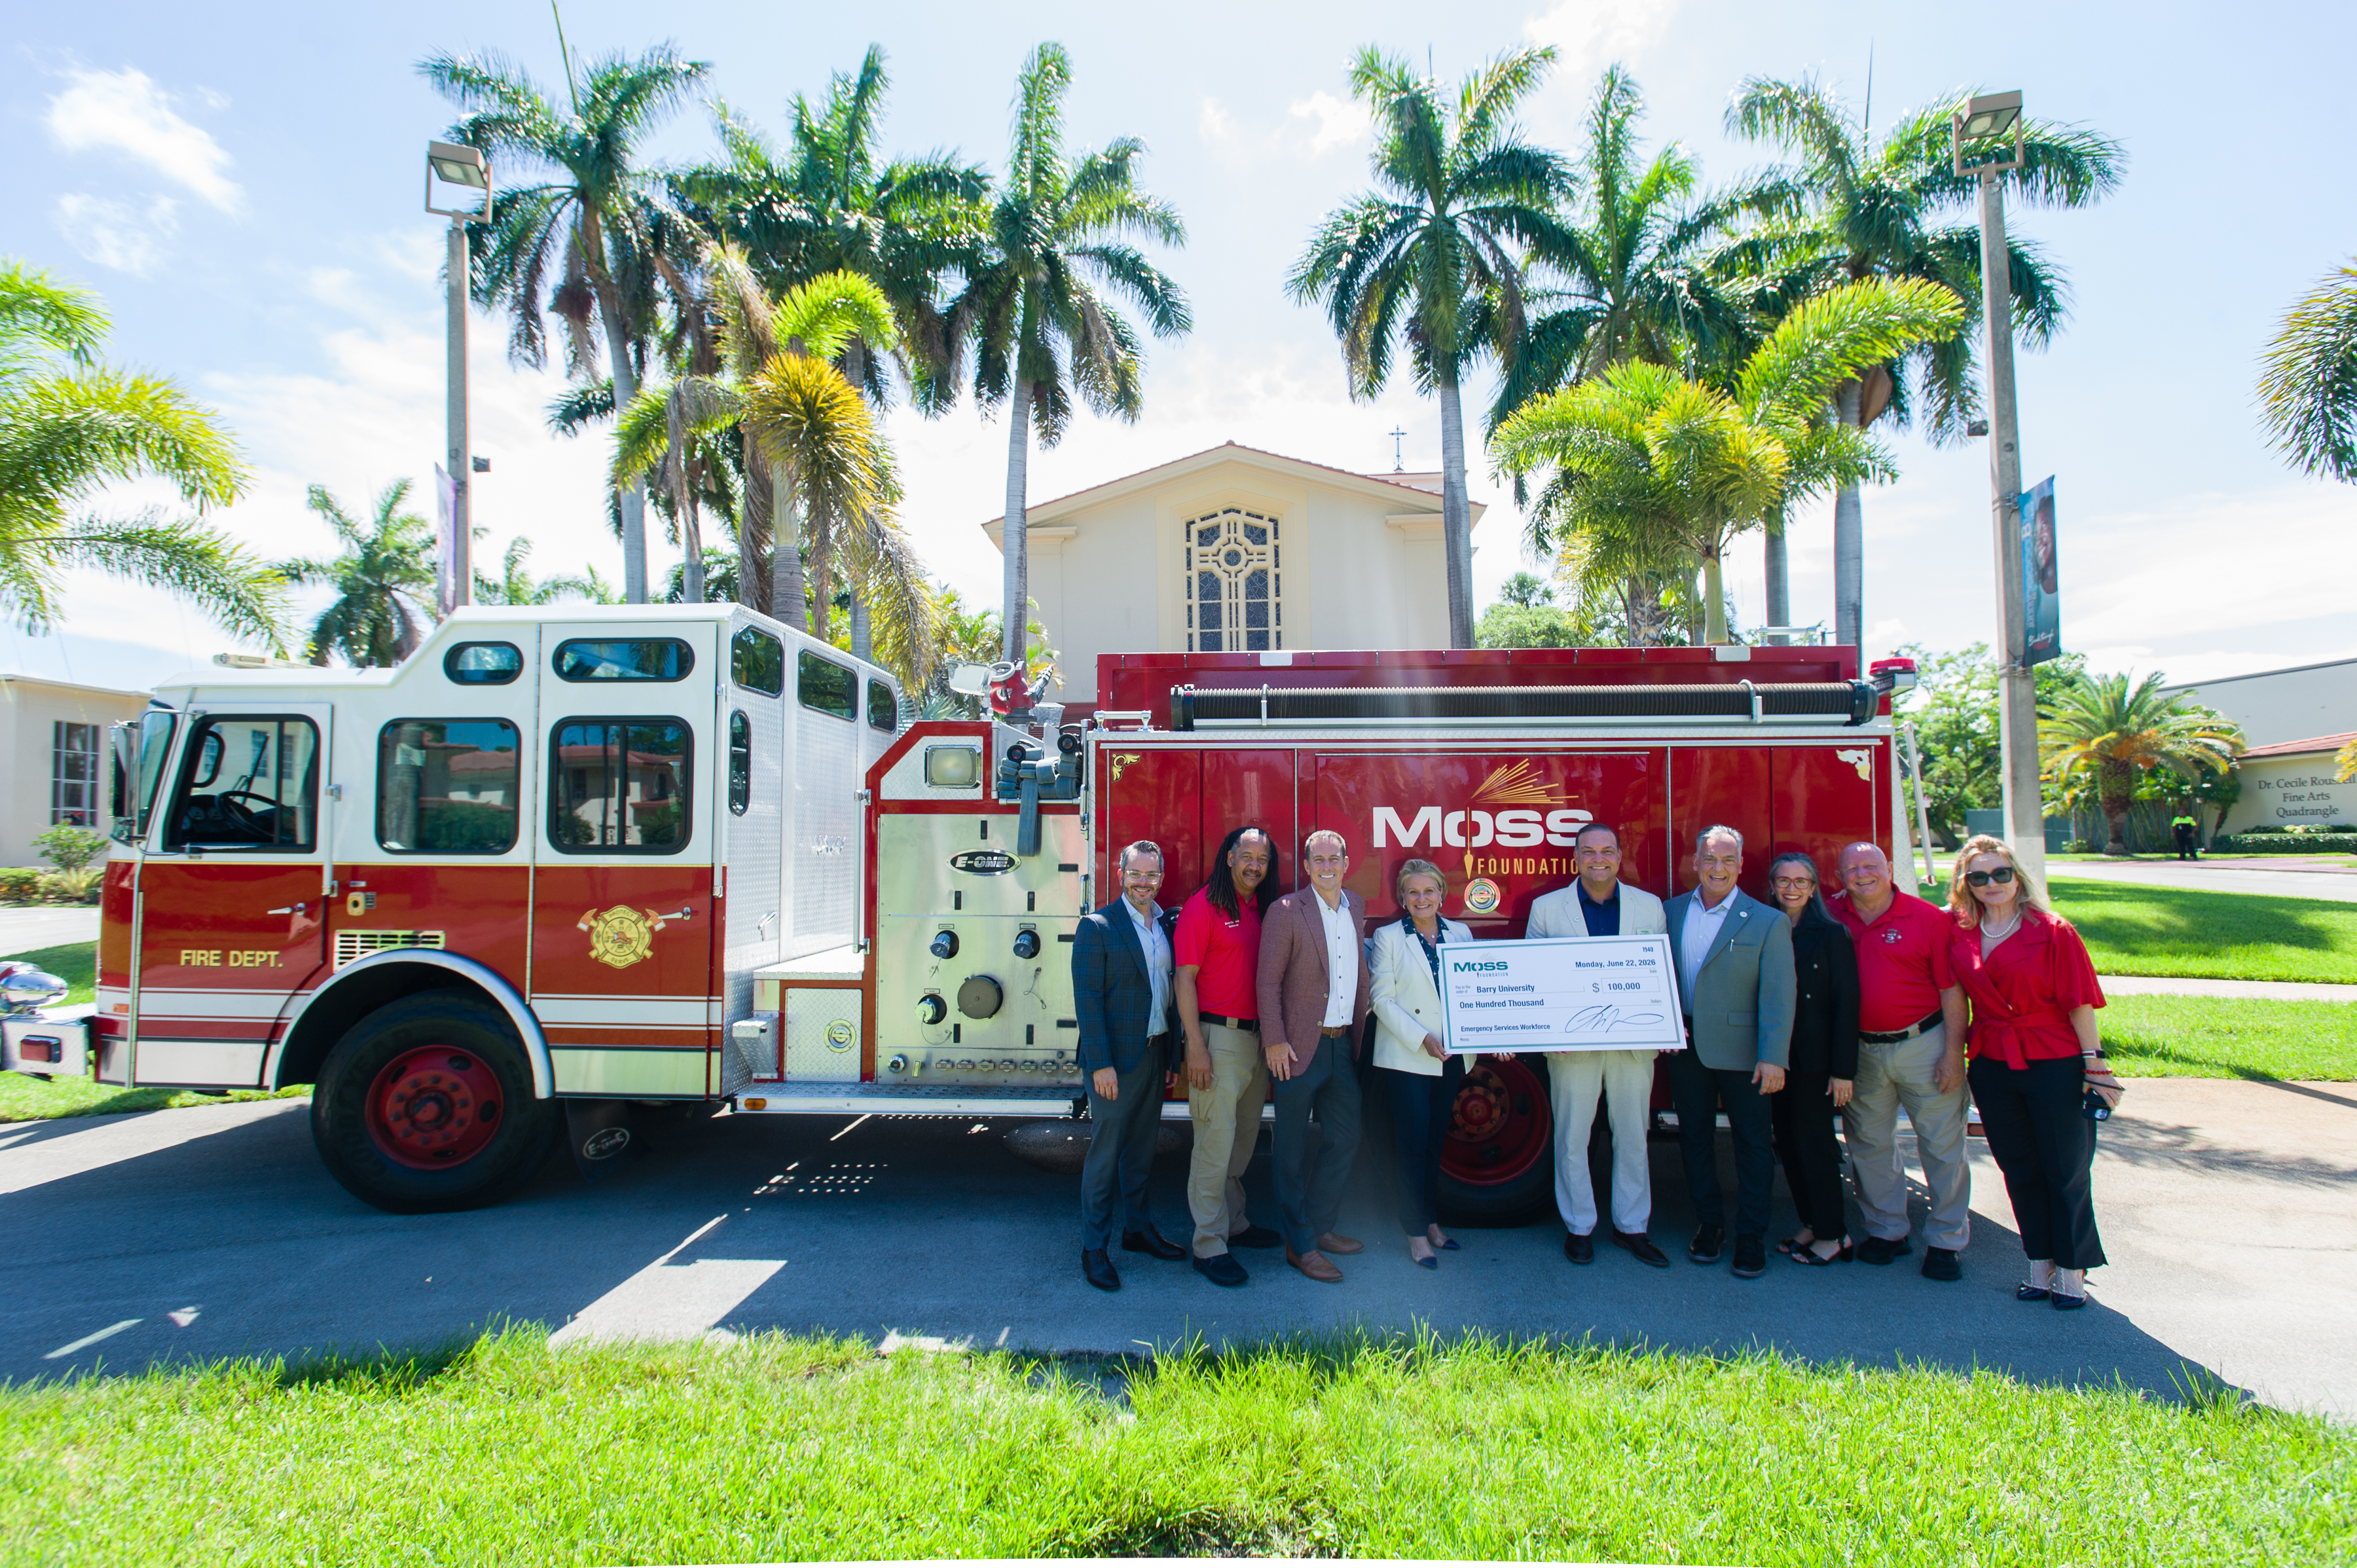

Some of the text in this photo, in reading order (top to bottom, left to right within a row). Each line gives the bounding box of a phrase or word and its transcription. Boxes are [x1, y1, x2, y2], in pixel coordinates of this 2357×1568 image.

[2258, 774, 2356, 790] Dr. Cecile Rousell
[2282, 792, 2330, 802] Fine Arts
[2276, 805, 2339, 818] Quadrangle
[1372, 806, 1594, 848] MOSS
[955, 856, 1009, 868] E-ONE
[1477, 858, 1579, 875] FOUNDATIO
[609, 909, 634, 918] PROTECT
[180, 949, 283, 968] FIRE DEPT.
[1453, 961, 1508, 972] MOSS
[1498, 984, 1535, 993] University
[1592, 982, 1641, 993] $ 100,000
[1475, 1000, 1506, 1008] Hundred
[1508, 998, 1544, 1007] Thousand
[1461, 1025, 1493, 1033] Emergency
